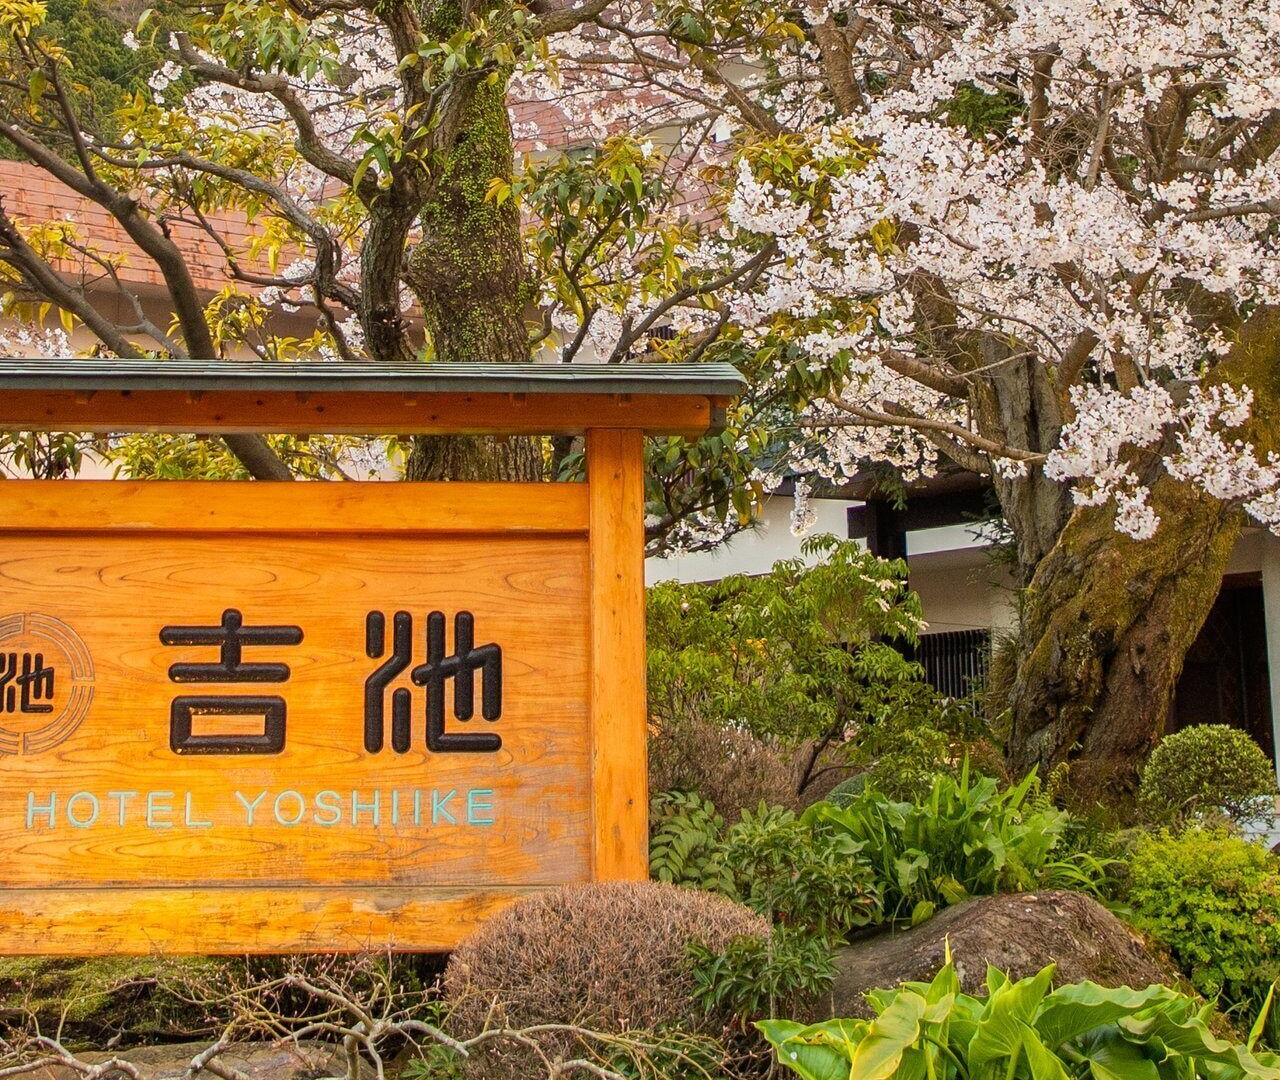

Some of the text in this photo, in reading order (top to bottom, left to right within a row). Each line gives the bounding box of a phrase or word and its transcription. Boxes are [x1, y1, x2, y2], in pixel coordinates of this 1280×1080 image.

[158, 608, 504, 755] 吉池
[25, 788, 495, 829] HOTEL YOSHIIKE
